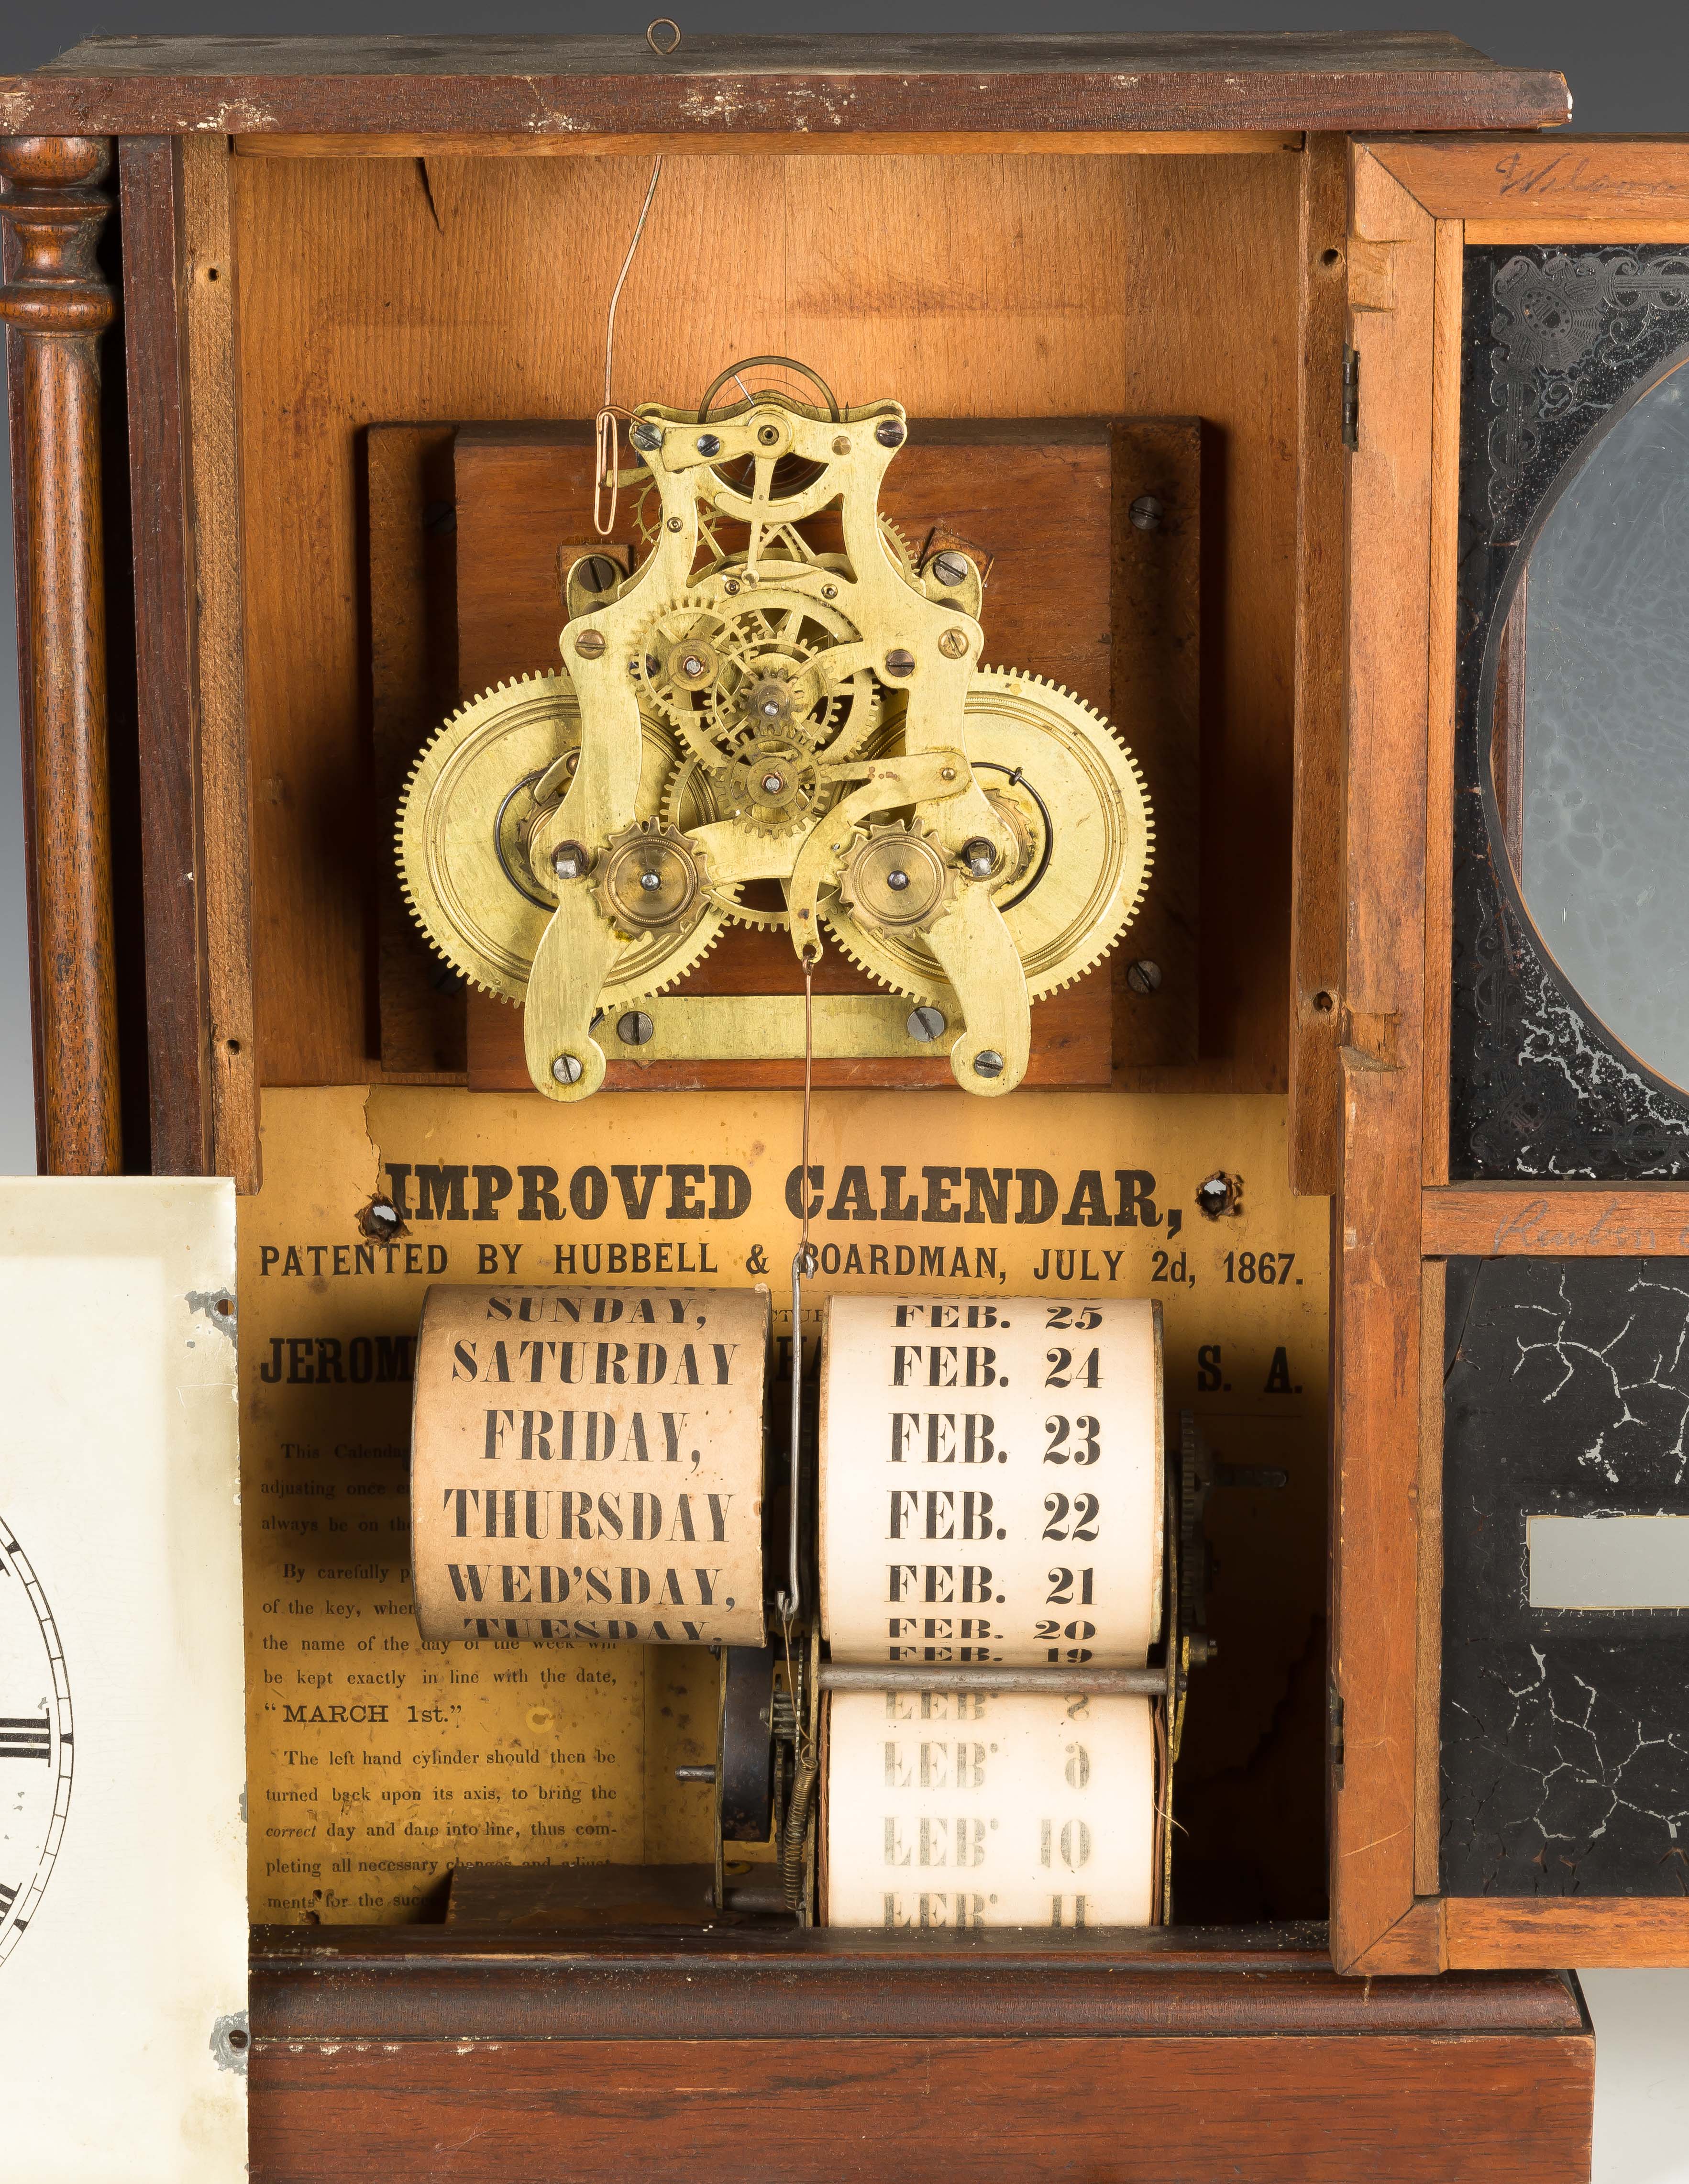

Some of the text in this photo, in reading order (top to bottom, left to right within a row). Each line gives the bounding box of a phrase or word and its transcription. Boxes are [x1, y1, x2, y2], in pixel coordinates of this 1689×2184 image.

[385, 1163, 1182, 1239] IMPROVED CALENDAR,
[259, 1244, 448, 1276] PATENTED
[477, 1244, 524, 1274] BY
[553, 1243, 718, 1275] HUBBELL
[746, 1243, 770, 1275] &
[1033, 1249, 1125, 1281] JULY
[1151, 1250, 1196, 1289] 2d,
[1224, 1251, 1303, 1286] 1867.
[486, 1297, 707, 1330] SUNDAY,
[894, 1305, 1103, 1330] FEB. 25
[261, 1336, 1303, 1394] JEROM S. A.
[452, 1339, 740, 1386] SATURDAY
[888, 1345, 1104, 1389] FEB. 24
[479, 1409, 700, 1474] FRIDAY,
[886, 1413, 1100, 1465] FEB. 23
[281, 1443, 320, 1459] This
[261, 1480, 335, 1500] adjusting
[347, 1483, 386, 1495] once
[262, 1516, 318, 1535] always
[329, 1517, 348, 1531] be
[359, 1522, 379, 1531] on
[443, 1488, 736, 1542] THURSDAY
[885, 1490, 1099, 1541] FEB. 22
[283, 1563, 305, 1583] By
[318, 1564, 390, 1584] carefully
[444, 1564, 735, 1612] WED'SDAY,
[884, 1565, 1097, 1605] FEB. 21
[262, 1599, 280, 1614] of
[289, 1599, 314, 1614] the
[325, 1600, 361, 1619] key,
[885, 1618, 1097, 1640] FEB. 20
[263, 1635, 288, 1651] the
[301, 1641, 344, 1651] name
[357, 1637, 376, 1651] of
[384, 1637, 409, 1651] the
[885, 1646, 1093, 1663] FEB. 19
[264, 1668, 617, 1689] be kept exactly in line with the date,
[284, 1749, 616, 1768] The left hand cylinder should then be
[266, 1785, 617, 1803] turned back upon its axis, to bring the
[266, 1826, 317, 1838] correct
[327, 1824, 355, 1841] day
[367, 1824, 395, 1837] and
[446, 1822, 478, 1836] into
[486, 1822, 520, 1839] line,
[531, 1821, 565, 1835] thus
[576, 1824, 617, 1836] com-
[266, 1859, 321, 1877] pleting
[332, 1858, 352, 1873] all
[358, 1860, 439, 1874] necessary
[267, 1896, 315, 1908] ments
[326, 1890, 348, 1907] for
[358, 1893, 383, 1907] the
